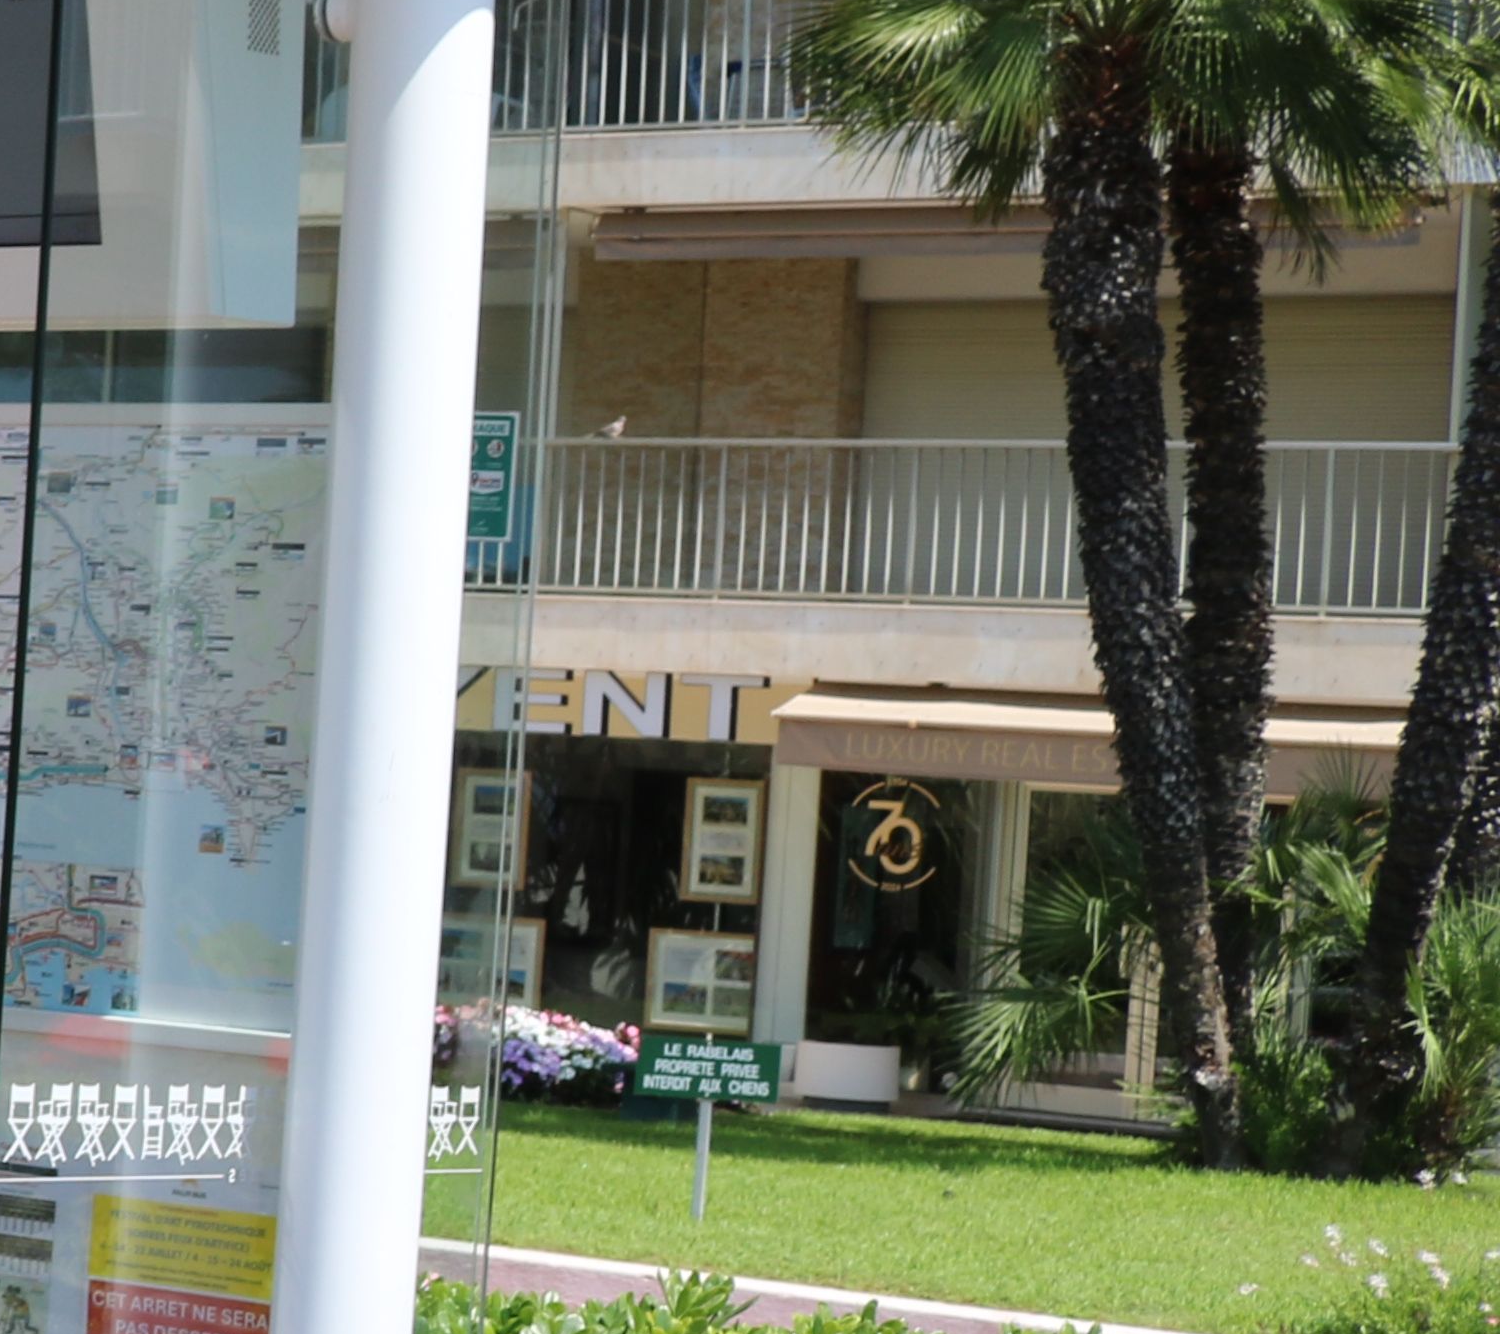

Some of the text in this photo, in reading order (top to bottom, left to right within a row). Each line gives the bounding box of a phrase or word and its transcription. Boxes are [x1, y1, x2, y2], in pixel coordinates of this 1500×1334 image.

[846, 729, 1109, 774] LUXURY REAL ES
[663, 1042, 755, 1063] LE RABELAIS
[642, 1074, 770, 1098] INTERDIT AUX CHIENS
[92, 1289, 269, 1330] CET ARRET NE SERA
